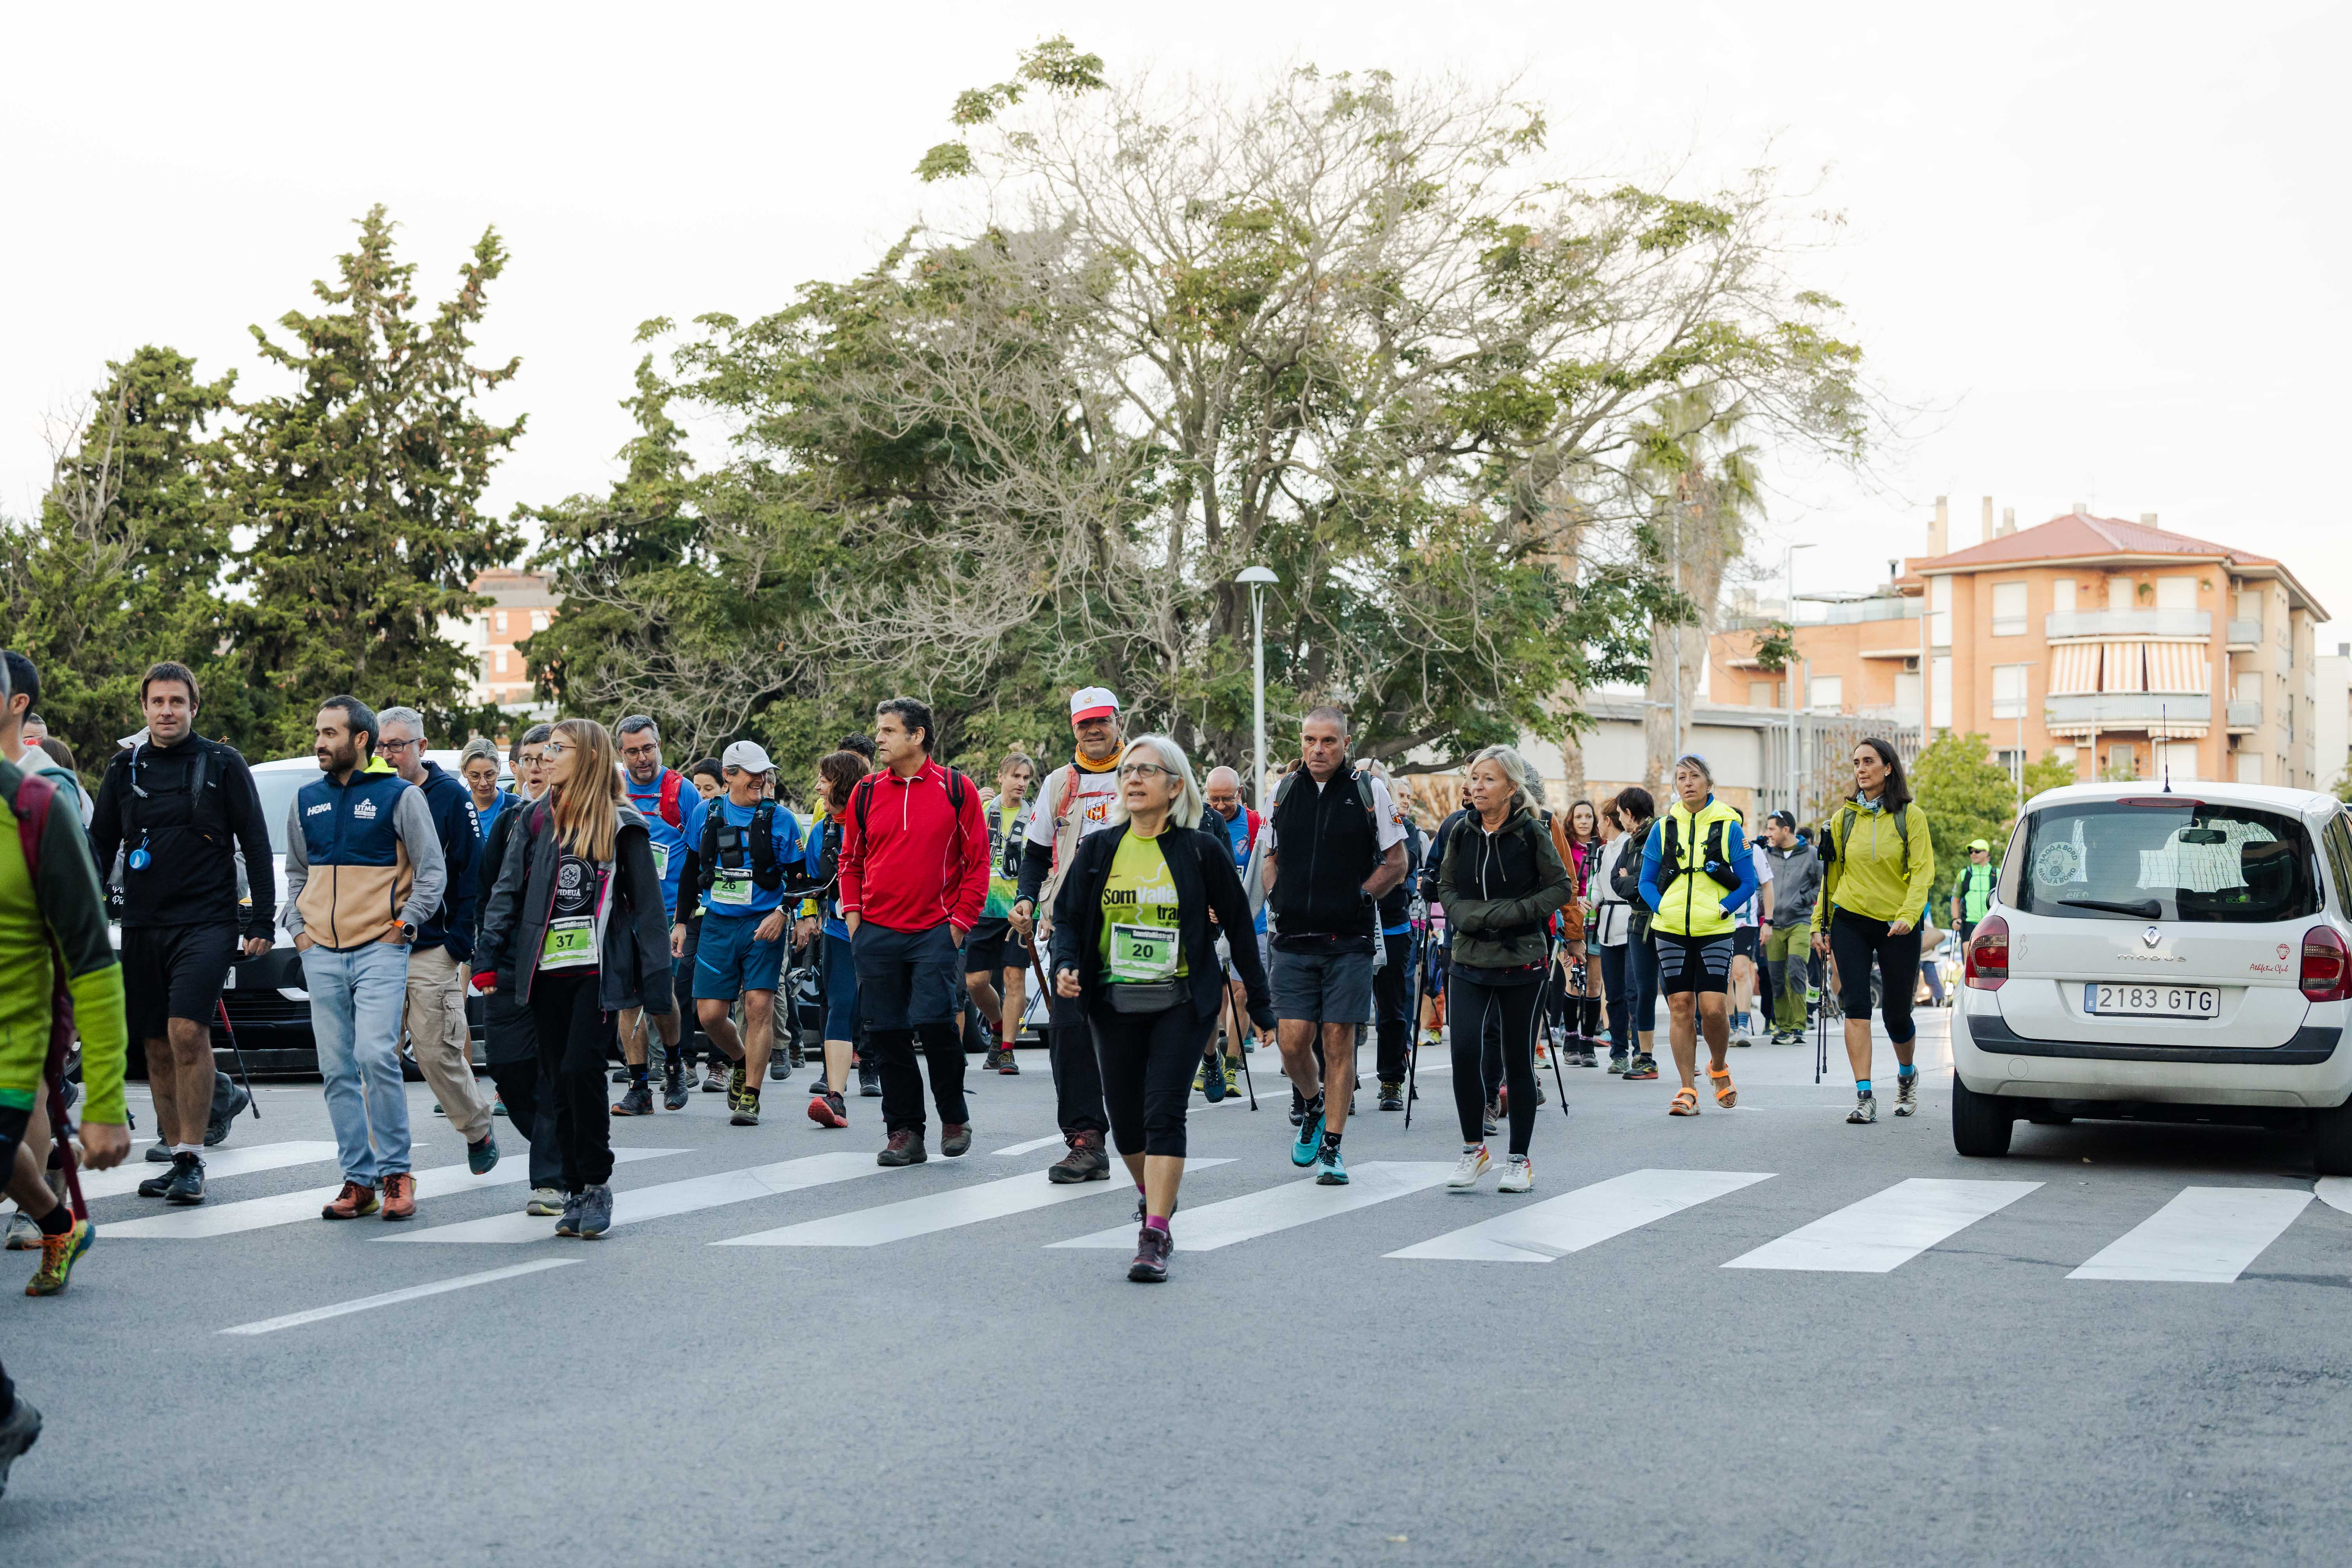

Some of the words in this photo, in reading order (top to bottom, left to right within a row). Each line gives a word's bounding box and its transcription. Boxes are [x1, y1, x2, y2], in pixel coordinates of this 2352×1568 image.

[307, 802, 331, 816] HOKA
[2063, 845, 2078, 860] BORD
[2059, 868, 2076, 883] BORD
[722, 881, 736, 890] 26
[556, 934, 574, 948] 37
[1132, 943, 1153, 958] 20
[2274, 964, 2288, 974] Club
[2099, 987, 2157, 1008] 2183
[2168, 989, 2212, 1011] GTG
